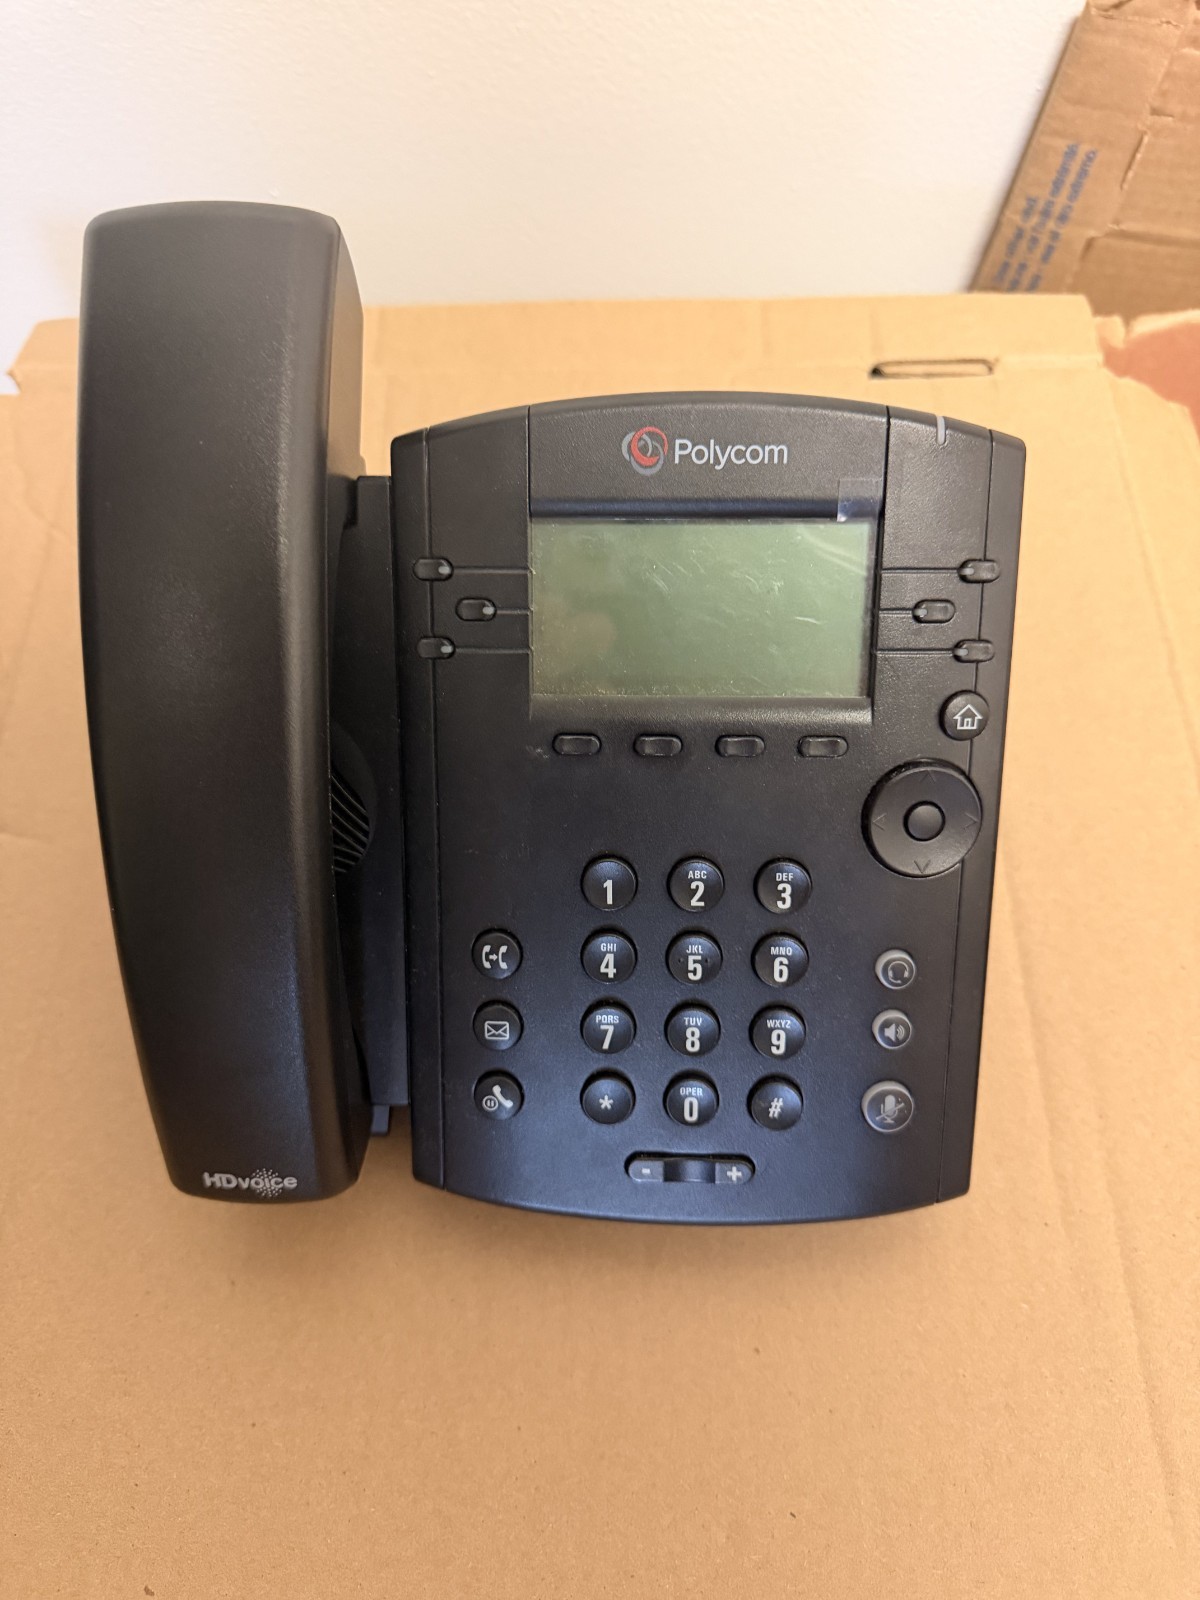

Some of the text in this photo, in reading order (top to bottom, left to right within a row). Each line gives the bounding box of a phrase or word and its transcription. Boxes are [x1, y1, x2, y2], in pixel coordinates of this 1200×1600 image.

[675, 439, 787, 469] Polycom
[776, 873, 793, 881] DEF
[604, 880, 612, 904] 1
[691, 881, 704, 906] 2
[777, 883, 791, 909] 3
[601, 943, 616, 951] GHI
[686, 945, 703, 953] JKL
[771, 947, 792, 955] MNO
[600, 953, 616, 978] 4
[688, 956, 702, 980] 5
[774, 957, 788, 982] 6
[596, 1015, 618, 1023] PQRS
[684, 1017, 702, 1025] TUV
[767, 1020, 791, 1028] WXYZ
[600, 1025, 614, 1049] 7
[686, 1027, 700, 1051] 8
[771, 1030, 785, 1054] 9
[679, 1088, 702, 1096] OPER
[684, 1097, 698, 1121] 0
[769, 1098, 783, 1117] #
